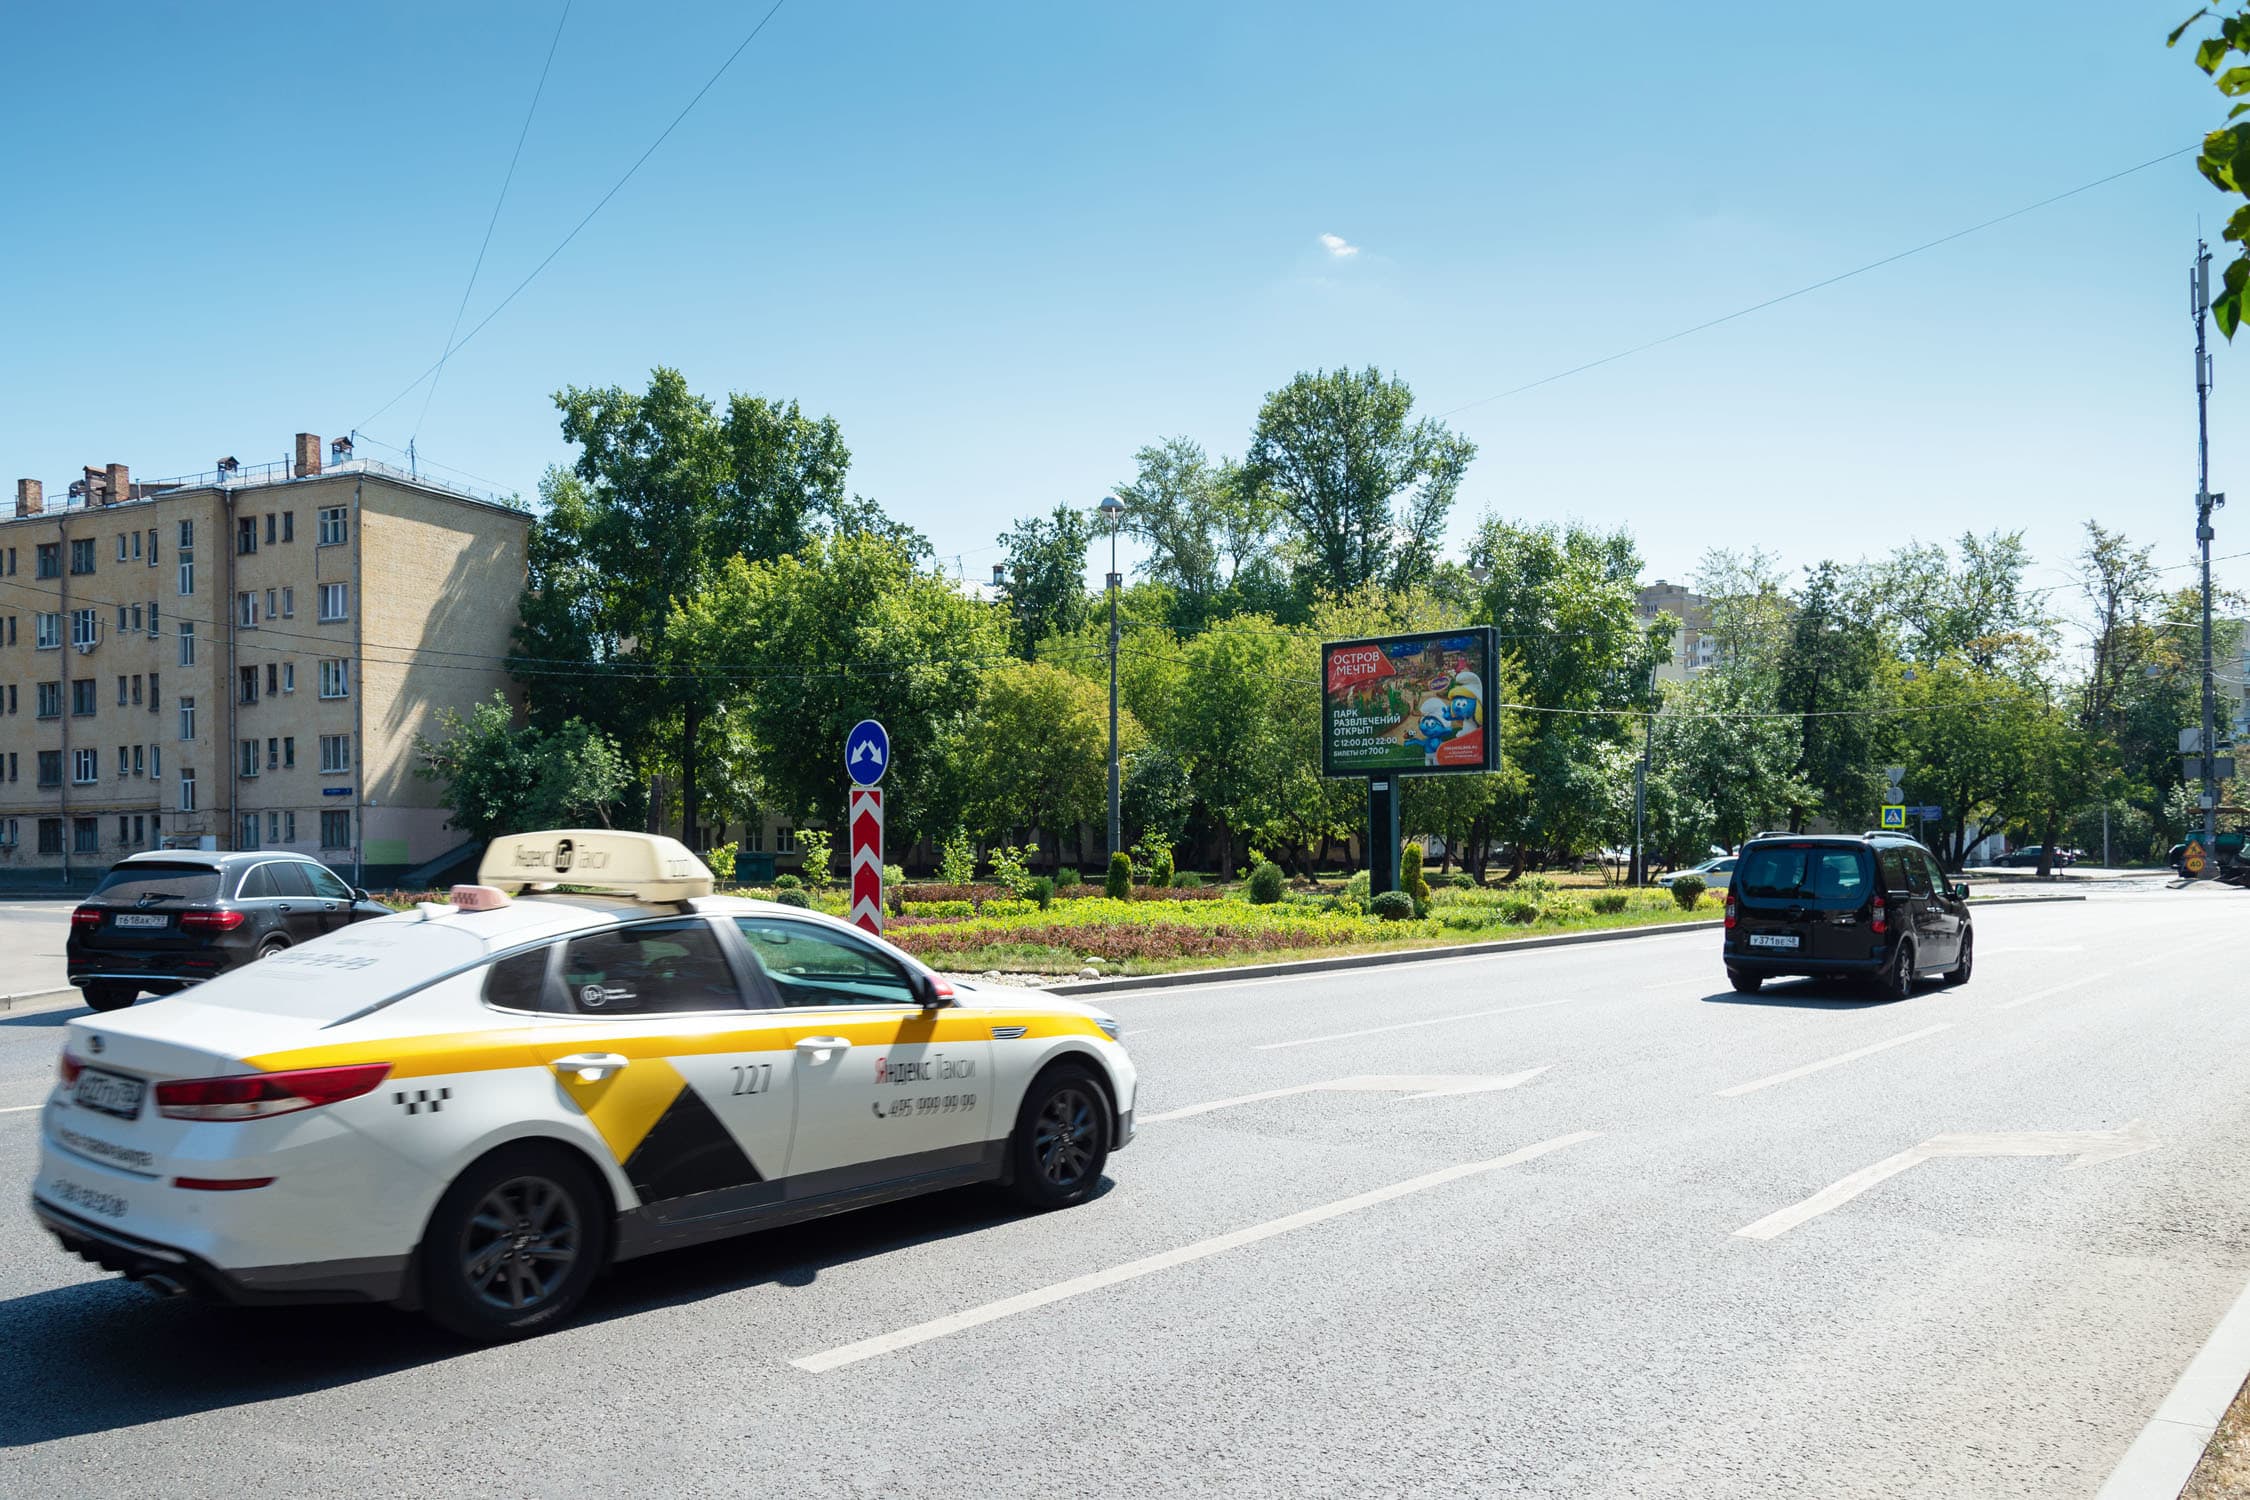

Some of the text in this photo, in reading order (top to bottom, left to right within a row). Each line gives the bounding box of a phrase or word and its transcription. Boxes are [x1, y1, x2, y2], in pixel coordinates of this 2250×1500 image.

[1333, 651, 1380, 665] ОСТРОВ
[1336, 663, 1377, 676] МЕЧТЫ
[1333, 709, 1358, 718] ПАРК
[1333, 713, 1401, 727] РАЗВЛЕЧЕНИЙ
[1333, 726, 1373, 736] ОТКРЫТ!
[1341, 738, 1360, 747] 12:00
[1361, 737, 1374, 747] ДО
[1375, 736, 1398, 745] 22:00
[1368, 747, 1384, 756] 700
[874, 1057, 931, 1085] Яндекс
[731, 1064, 773, 1096] 227
